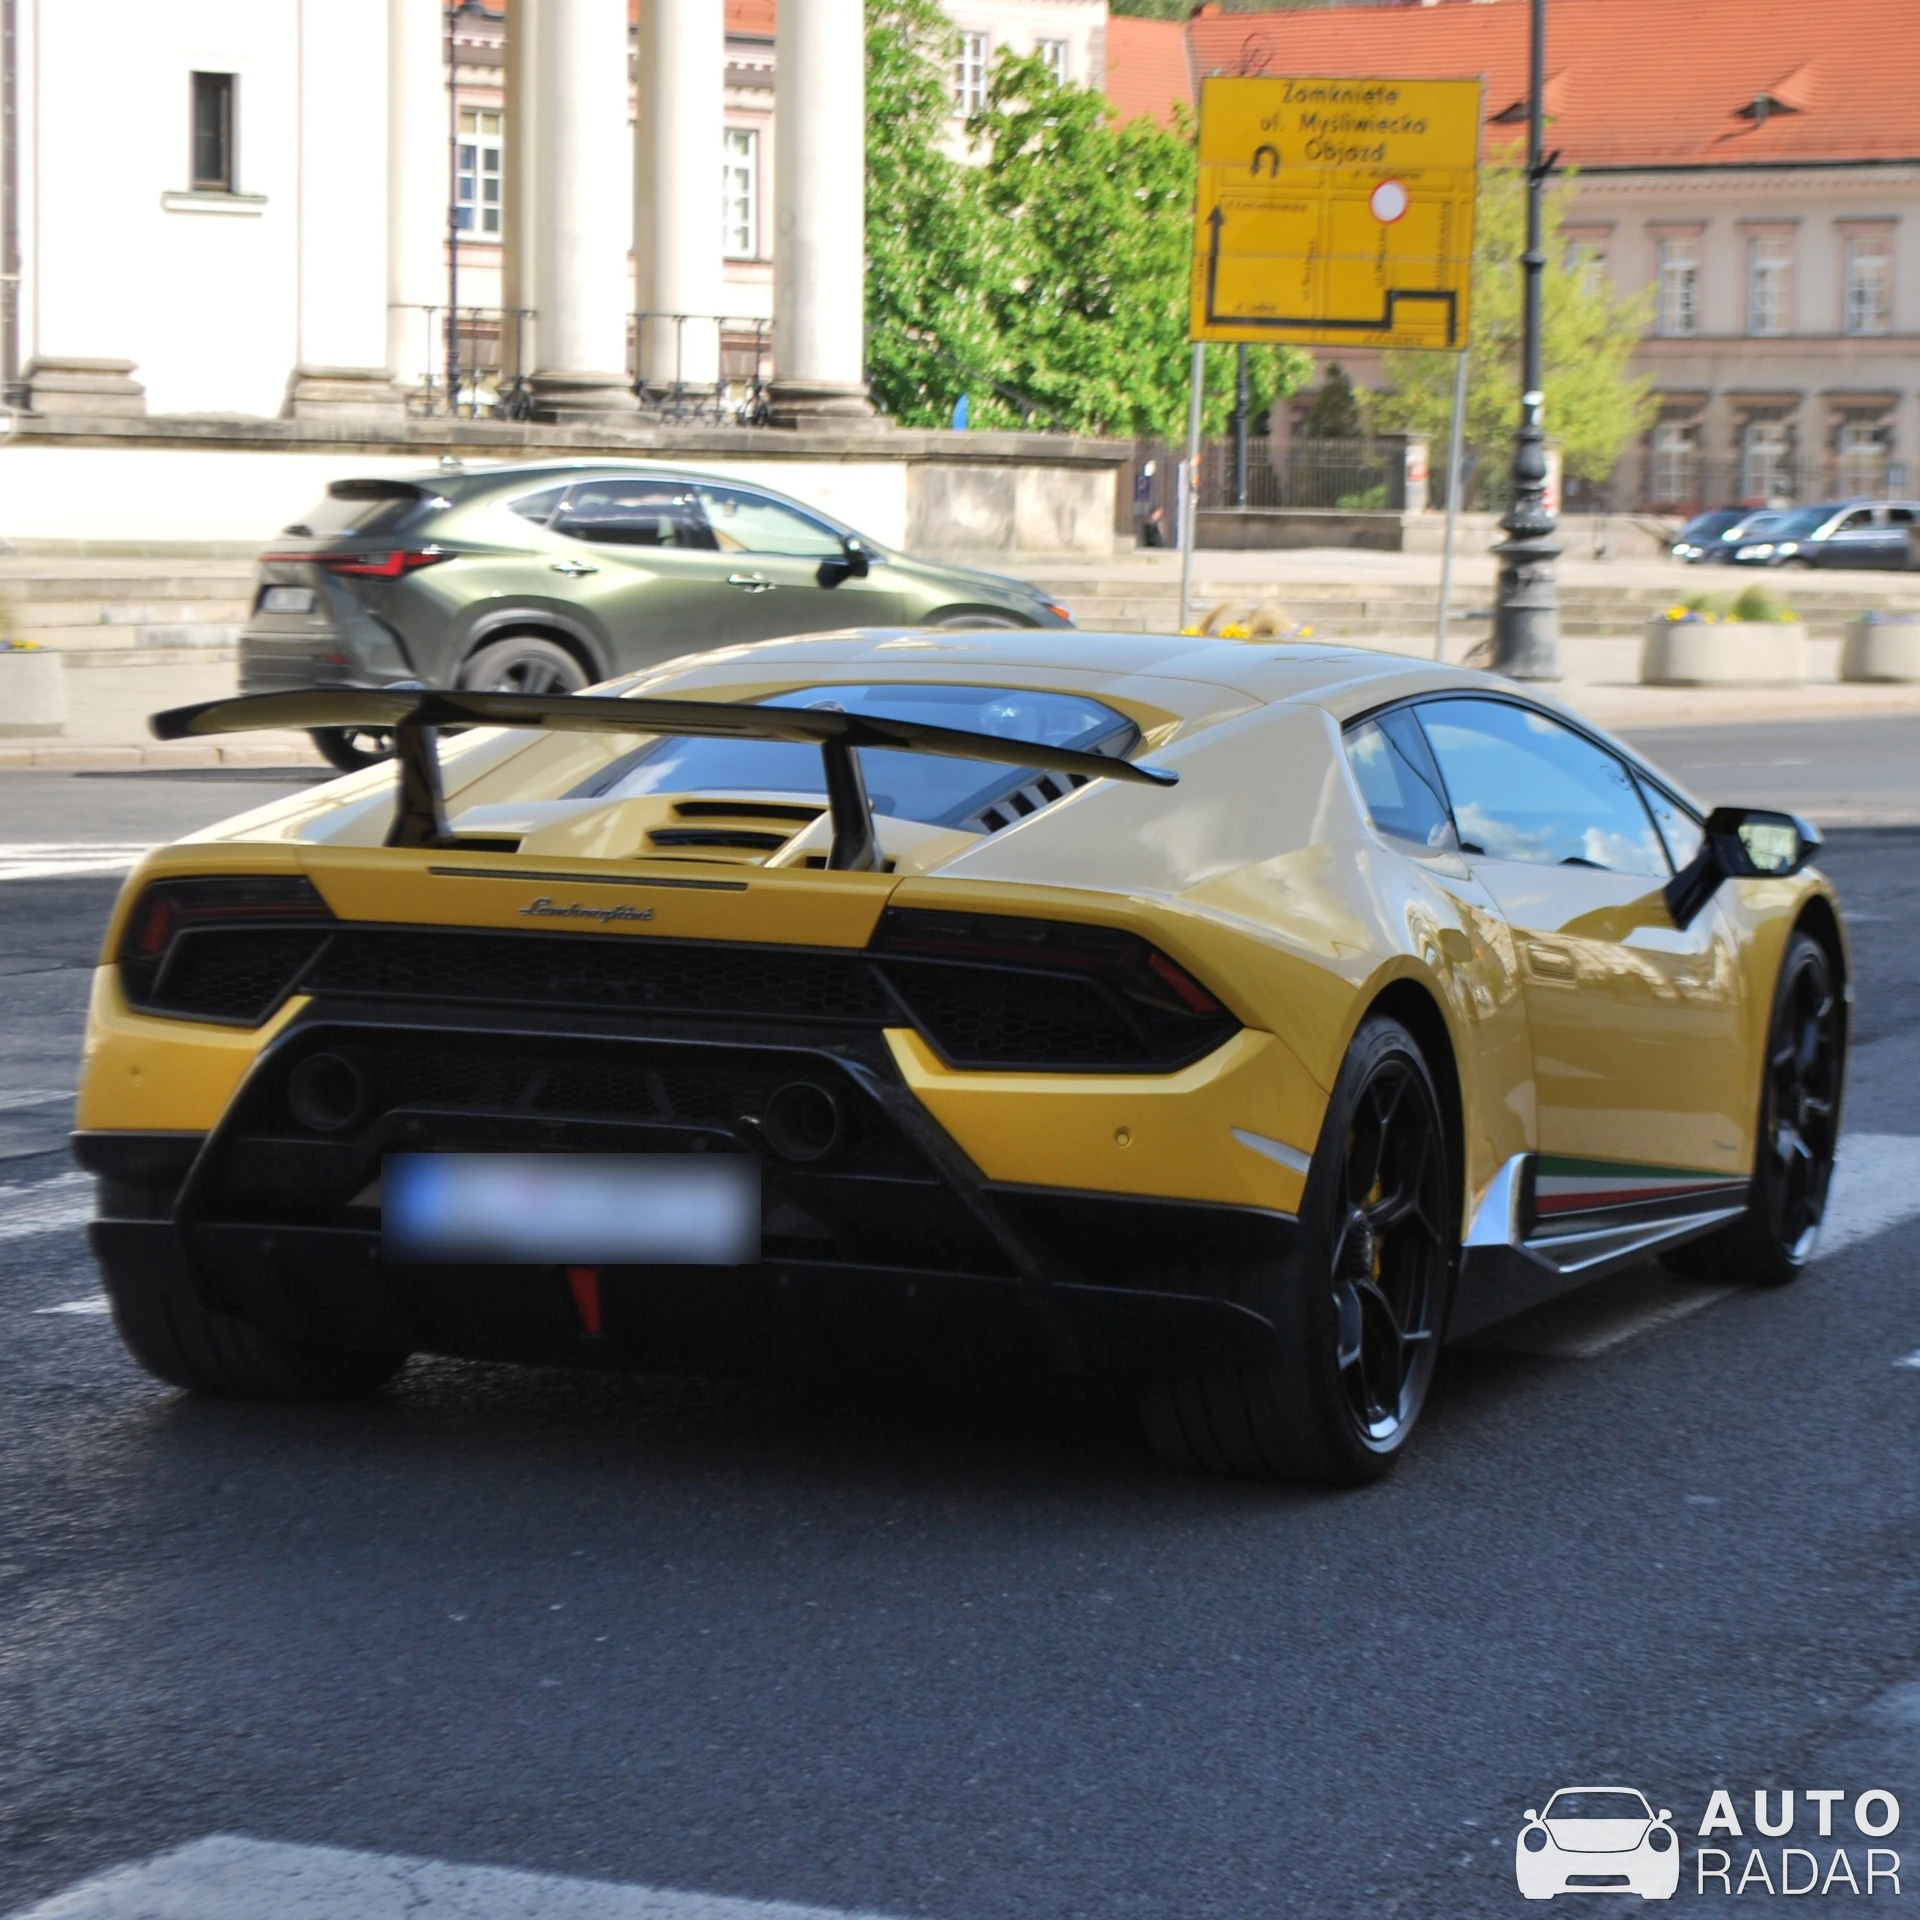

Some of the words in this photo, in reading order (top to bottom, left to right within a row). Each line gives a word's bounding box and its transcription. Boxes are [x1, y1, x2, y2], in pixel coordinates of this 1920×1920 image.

[1260, 110, 1283, 133] ul.
[1304, 138, 1387, 166] Objazd
[519, 897, 654, 923] Lamborghini
